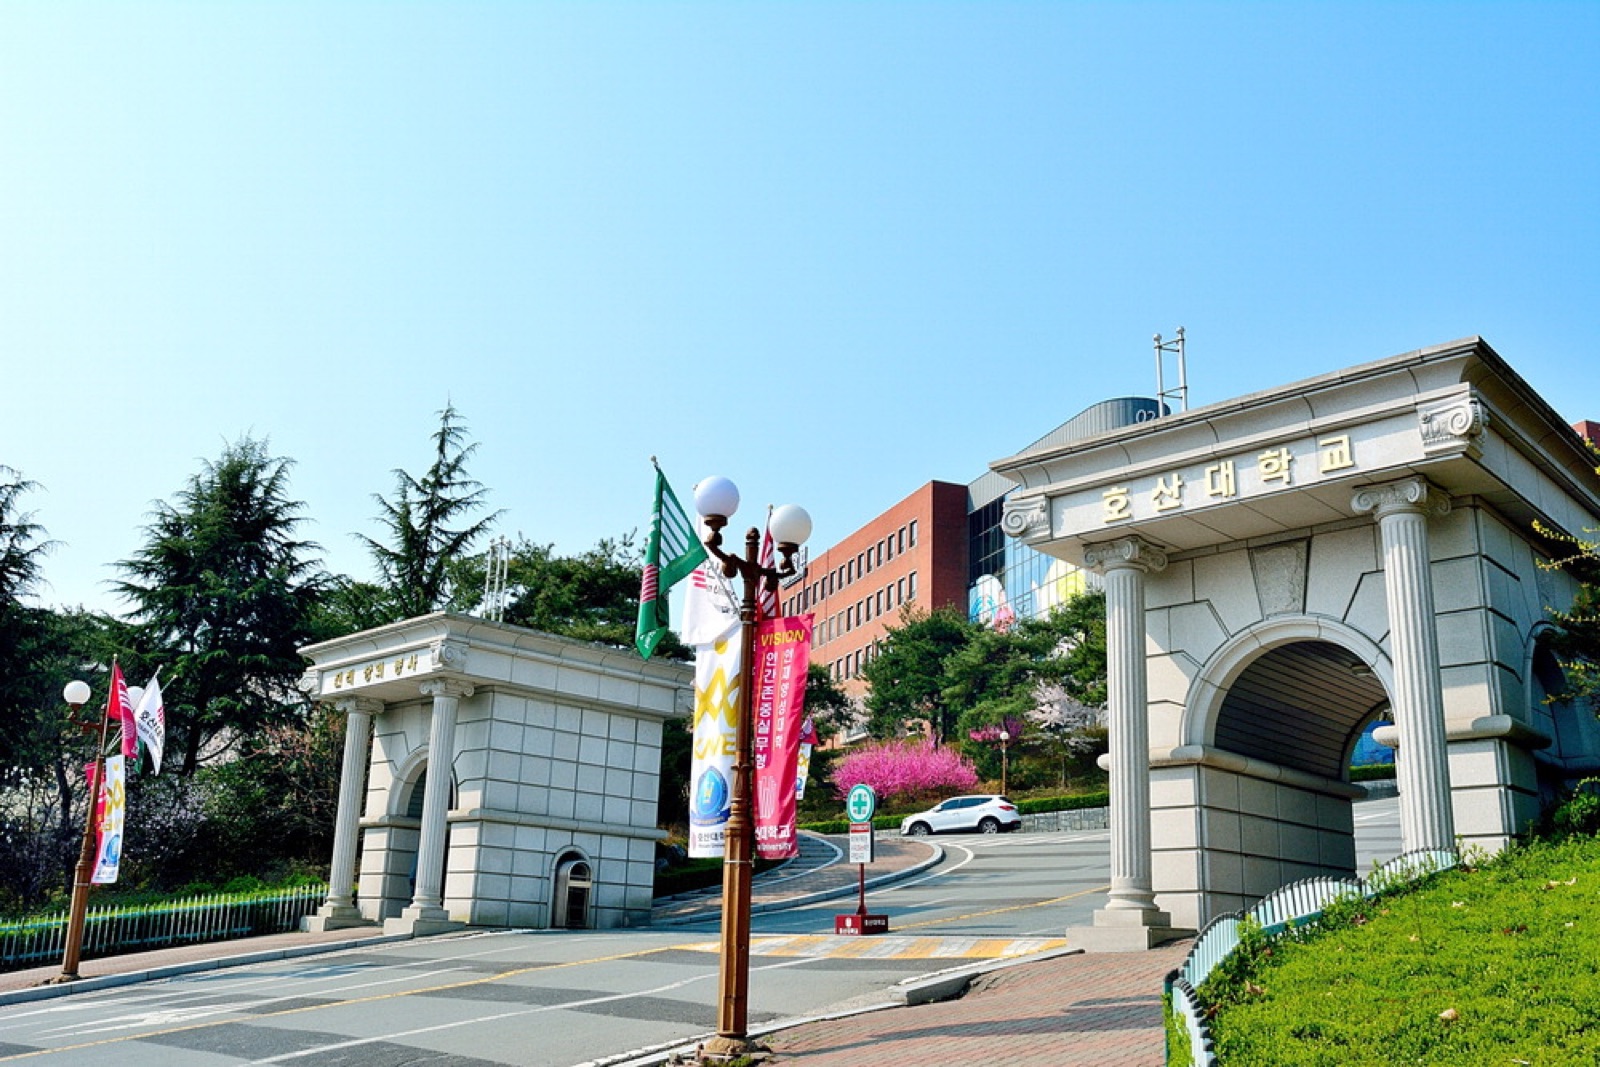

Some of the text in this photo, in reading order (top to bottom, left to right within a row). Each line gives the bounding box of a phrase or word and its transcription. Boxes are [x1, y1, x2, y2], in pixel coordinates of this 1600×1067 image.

[1102, 434, 1355, 524] 호산대학교
[761, 629, 805, 647] VISION
[755, 824, 791, 841] 산대학교
